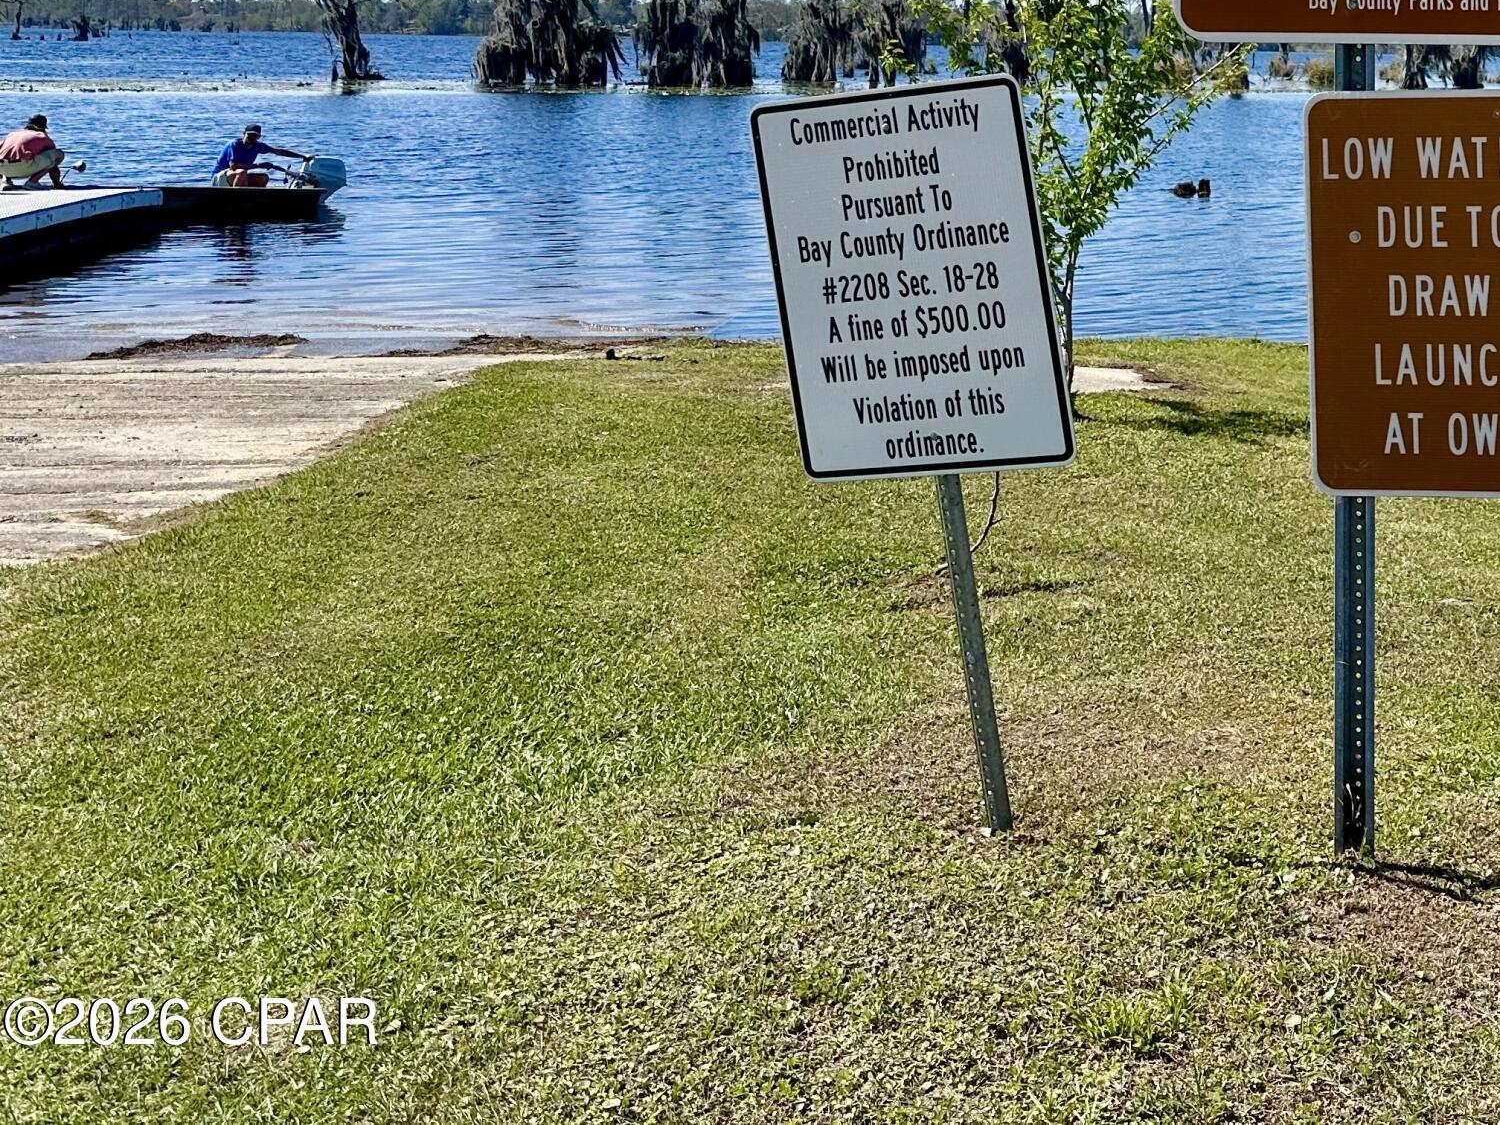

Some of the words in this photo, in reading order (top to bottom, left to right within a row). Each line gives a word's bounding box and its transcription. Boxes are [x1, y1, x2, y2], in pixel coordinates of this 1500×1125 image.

[790, 107, 898, 145] Commercial
[908, 99, 978, 132] Activity
[843, 147, 939, 183] Prohibited
[1323, 138, 1393, 179] LOW
[842, 187, 925, 221] Pursuant
[929, 184, 952, 211] To
[798, 236, 831, 267] Bay
[841, 227, 904, 260] County
[913, 221, 1009, 251] Ordinance
[1378, 206, 1448, 247] DUE
[823, 272, 889, 304] #2208
[897, 270, 936, 297] Sec.
[943, 262, 999, 292] 18-28
[1389, 275, 1490, 316] DRAW
[830, 317, 842, 343] A
[848, 314, 883, 341] fine
[891, 310, 908, 337] of
[916, 301, 1005, 338] $500.00
[821, 355, 857, 383] Will
[865, 354, 886, 380] be
[894, 345, 970, 382] imposed
[979, 347, 1025, 376] upon
[853, 394, 937, 424] Violation
[945, 390, 962, 417] of
[968, 387, 1004, 415] this
[886, 430, 984, 459] ordinance.
[1384, 413, 1423, 454] AT
